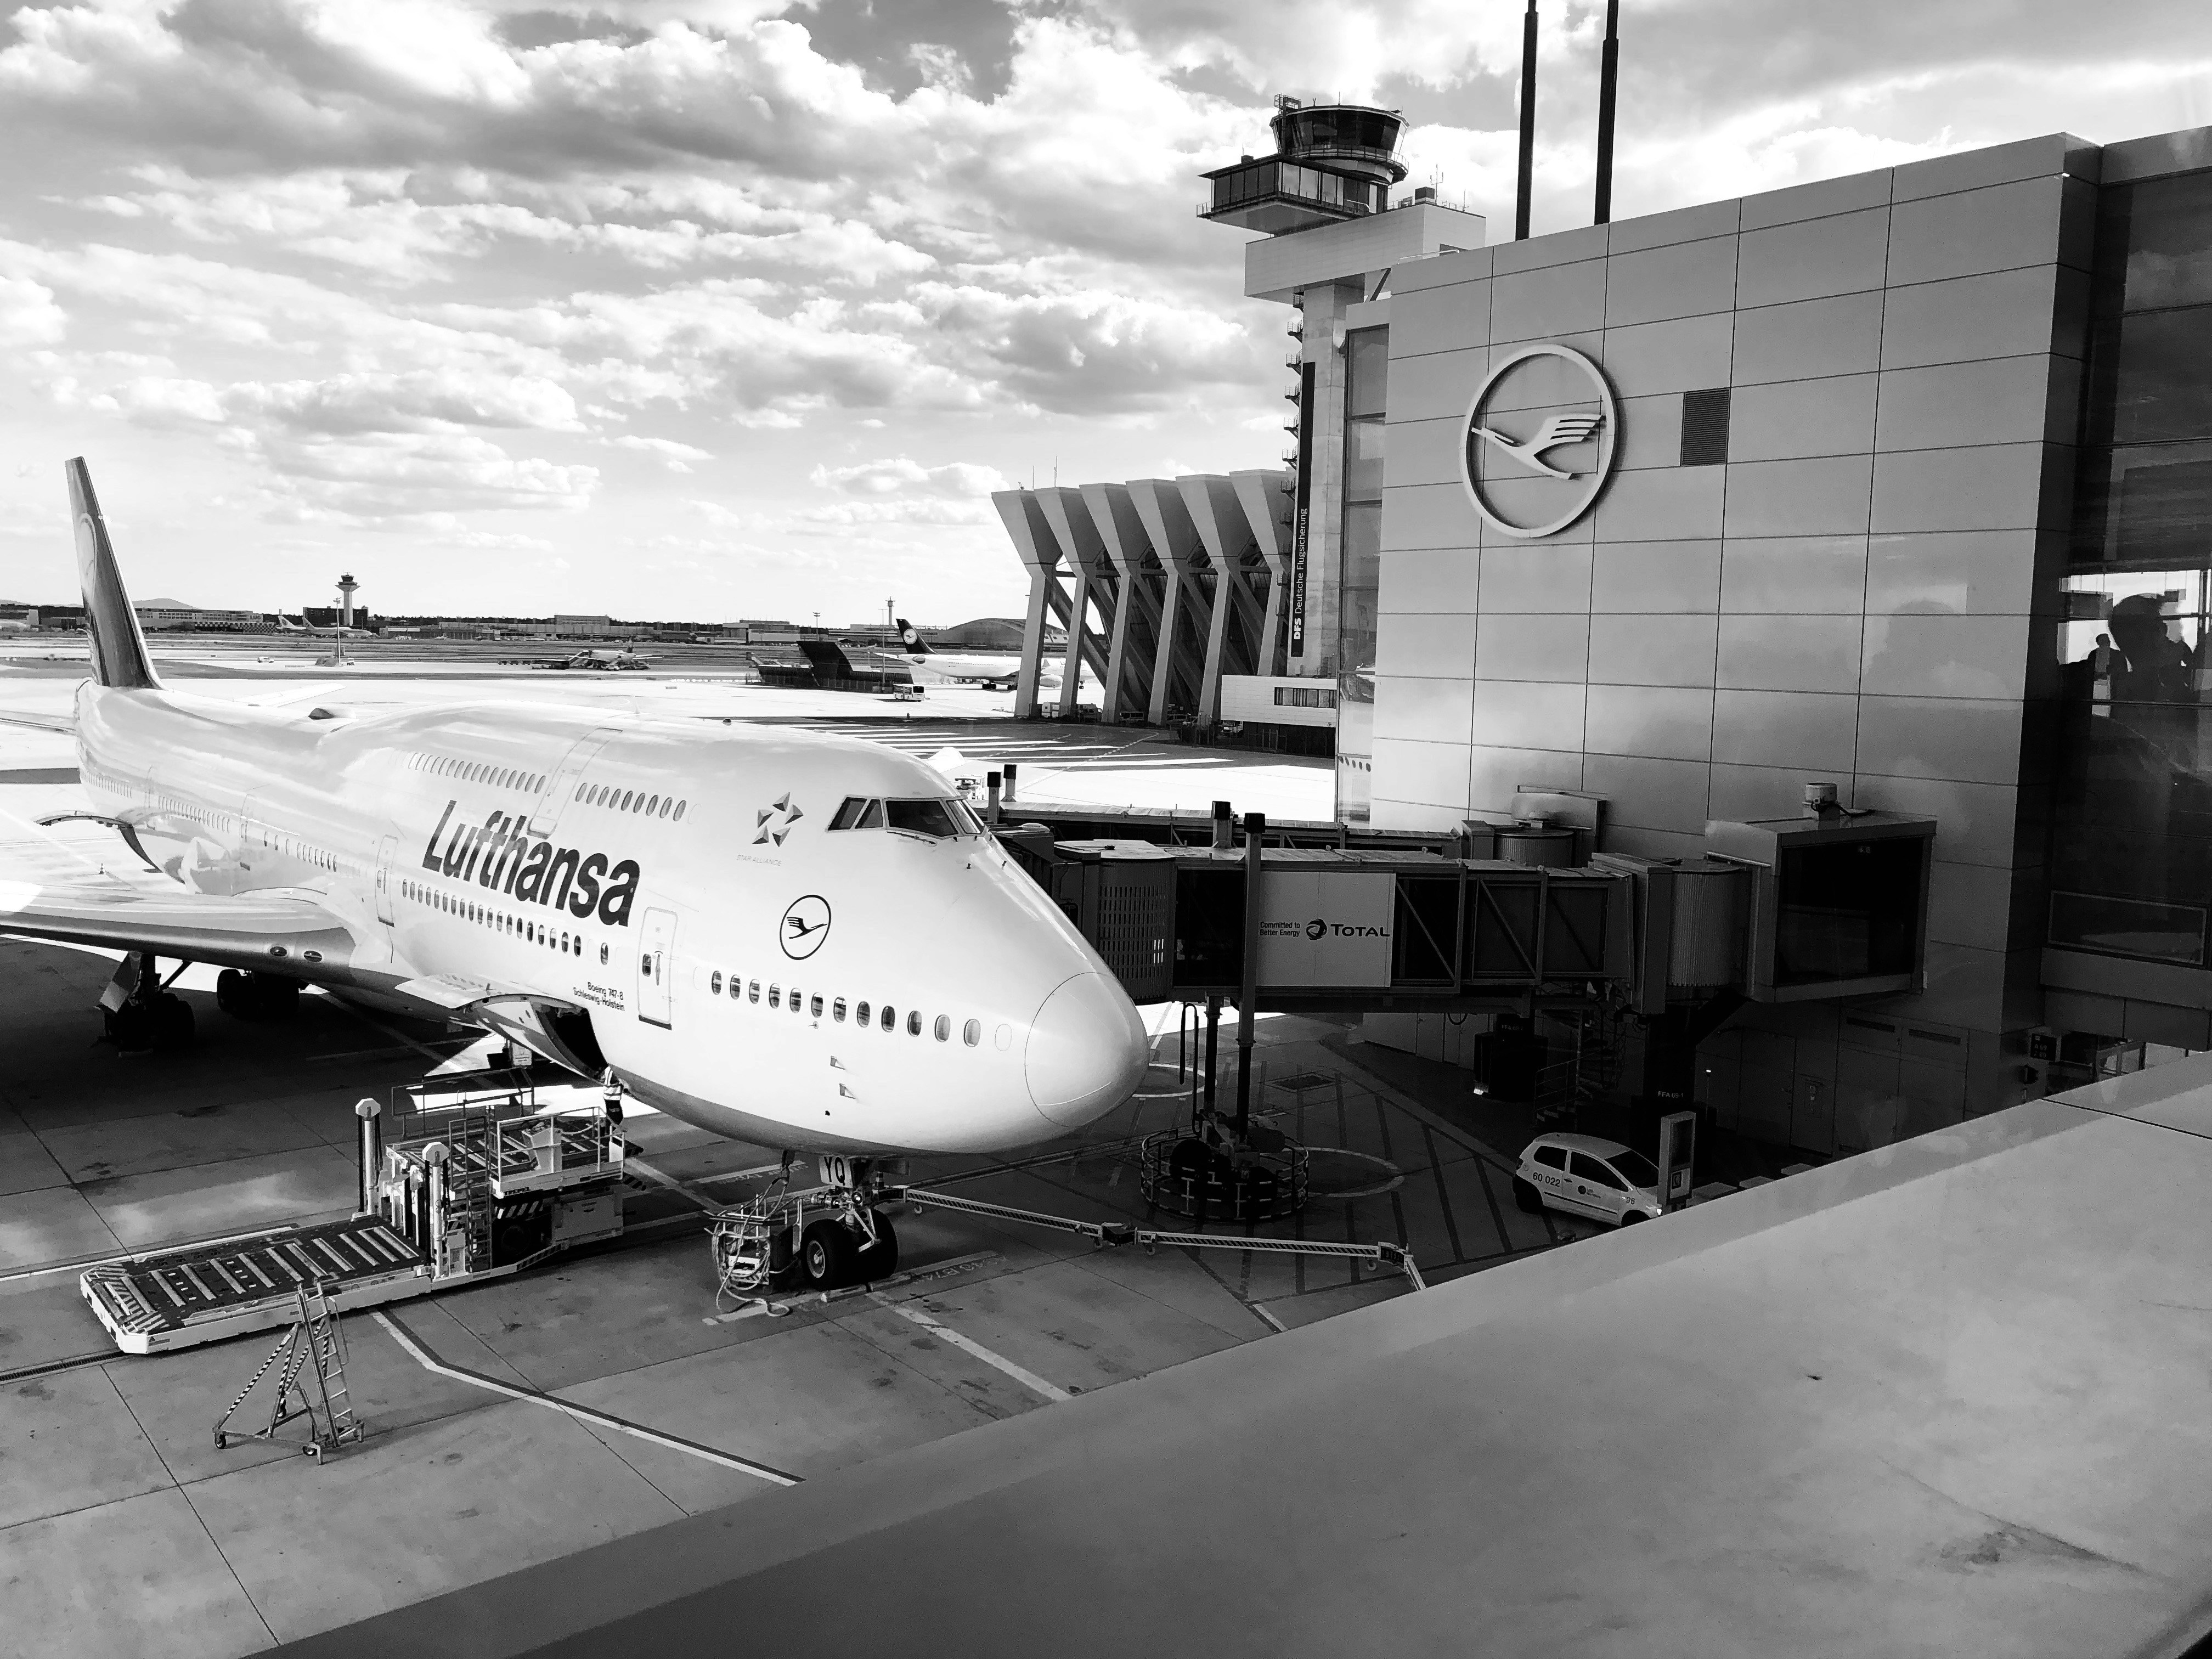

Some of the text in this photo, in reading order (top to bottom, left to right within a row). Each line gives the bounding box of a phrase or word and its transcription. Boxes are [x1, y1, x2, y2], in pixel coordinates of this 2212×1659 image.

[1296, 508, 1308, 570] Flugsicherung
[1295, 573, 1304, 614] Deutsche
[421, 800, 641, 927] Lufthansa
[752, 856, 782, 866] ALLIANCE
[1279, 929, 1300, 938] Energy
[1330, 923, 1391, 938] TOTAL
[573, 987, 625, 1012] Schleswig-Holstein
[587, 981, 624, 1000] Boeing 747-8
[823, 1156, 845, 1186] YQ
[1533, 1172, 1561, 1187] 60 022
